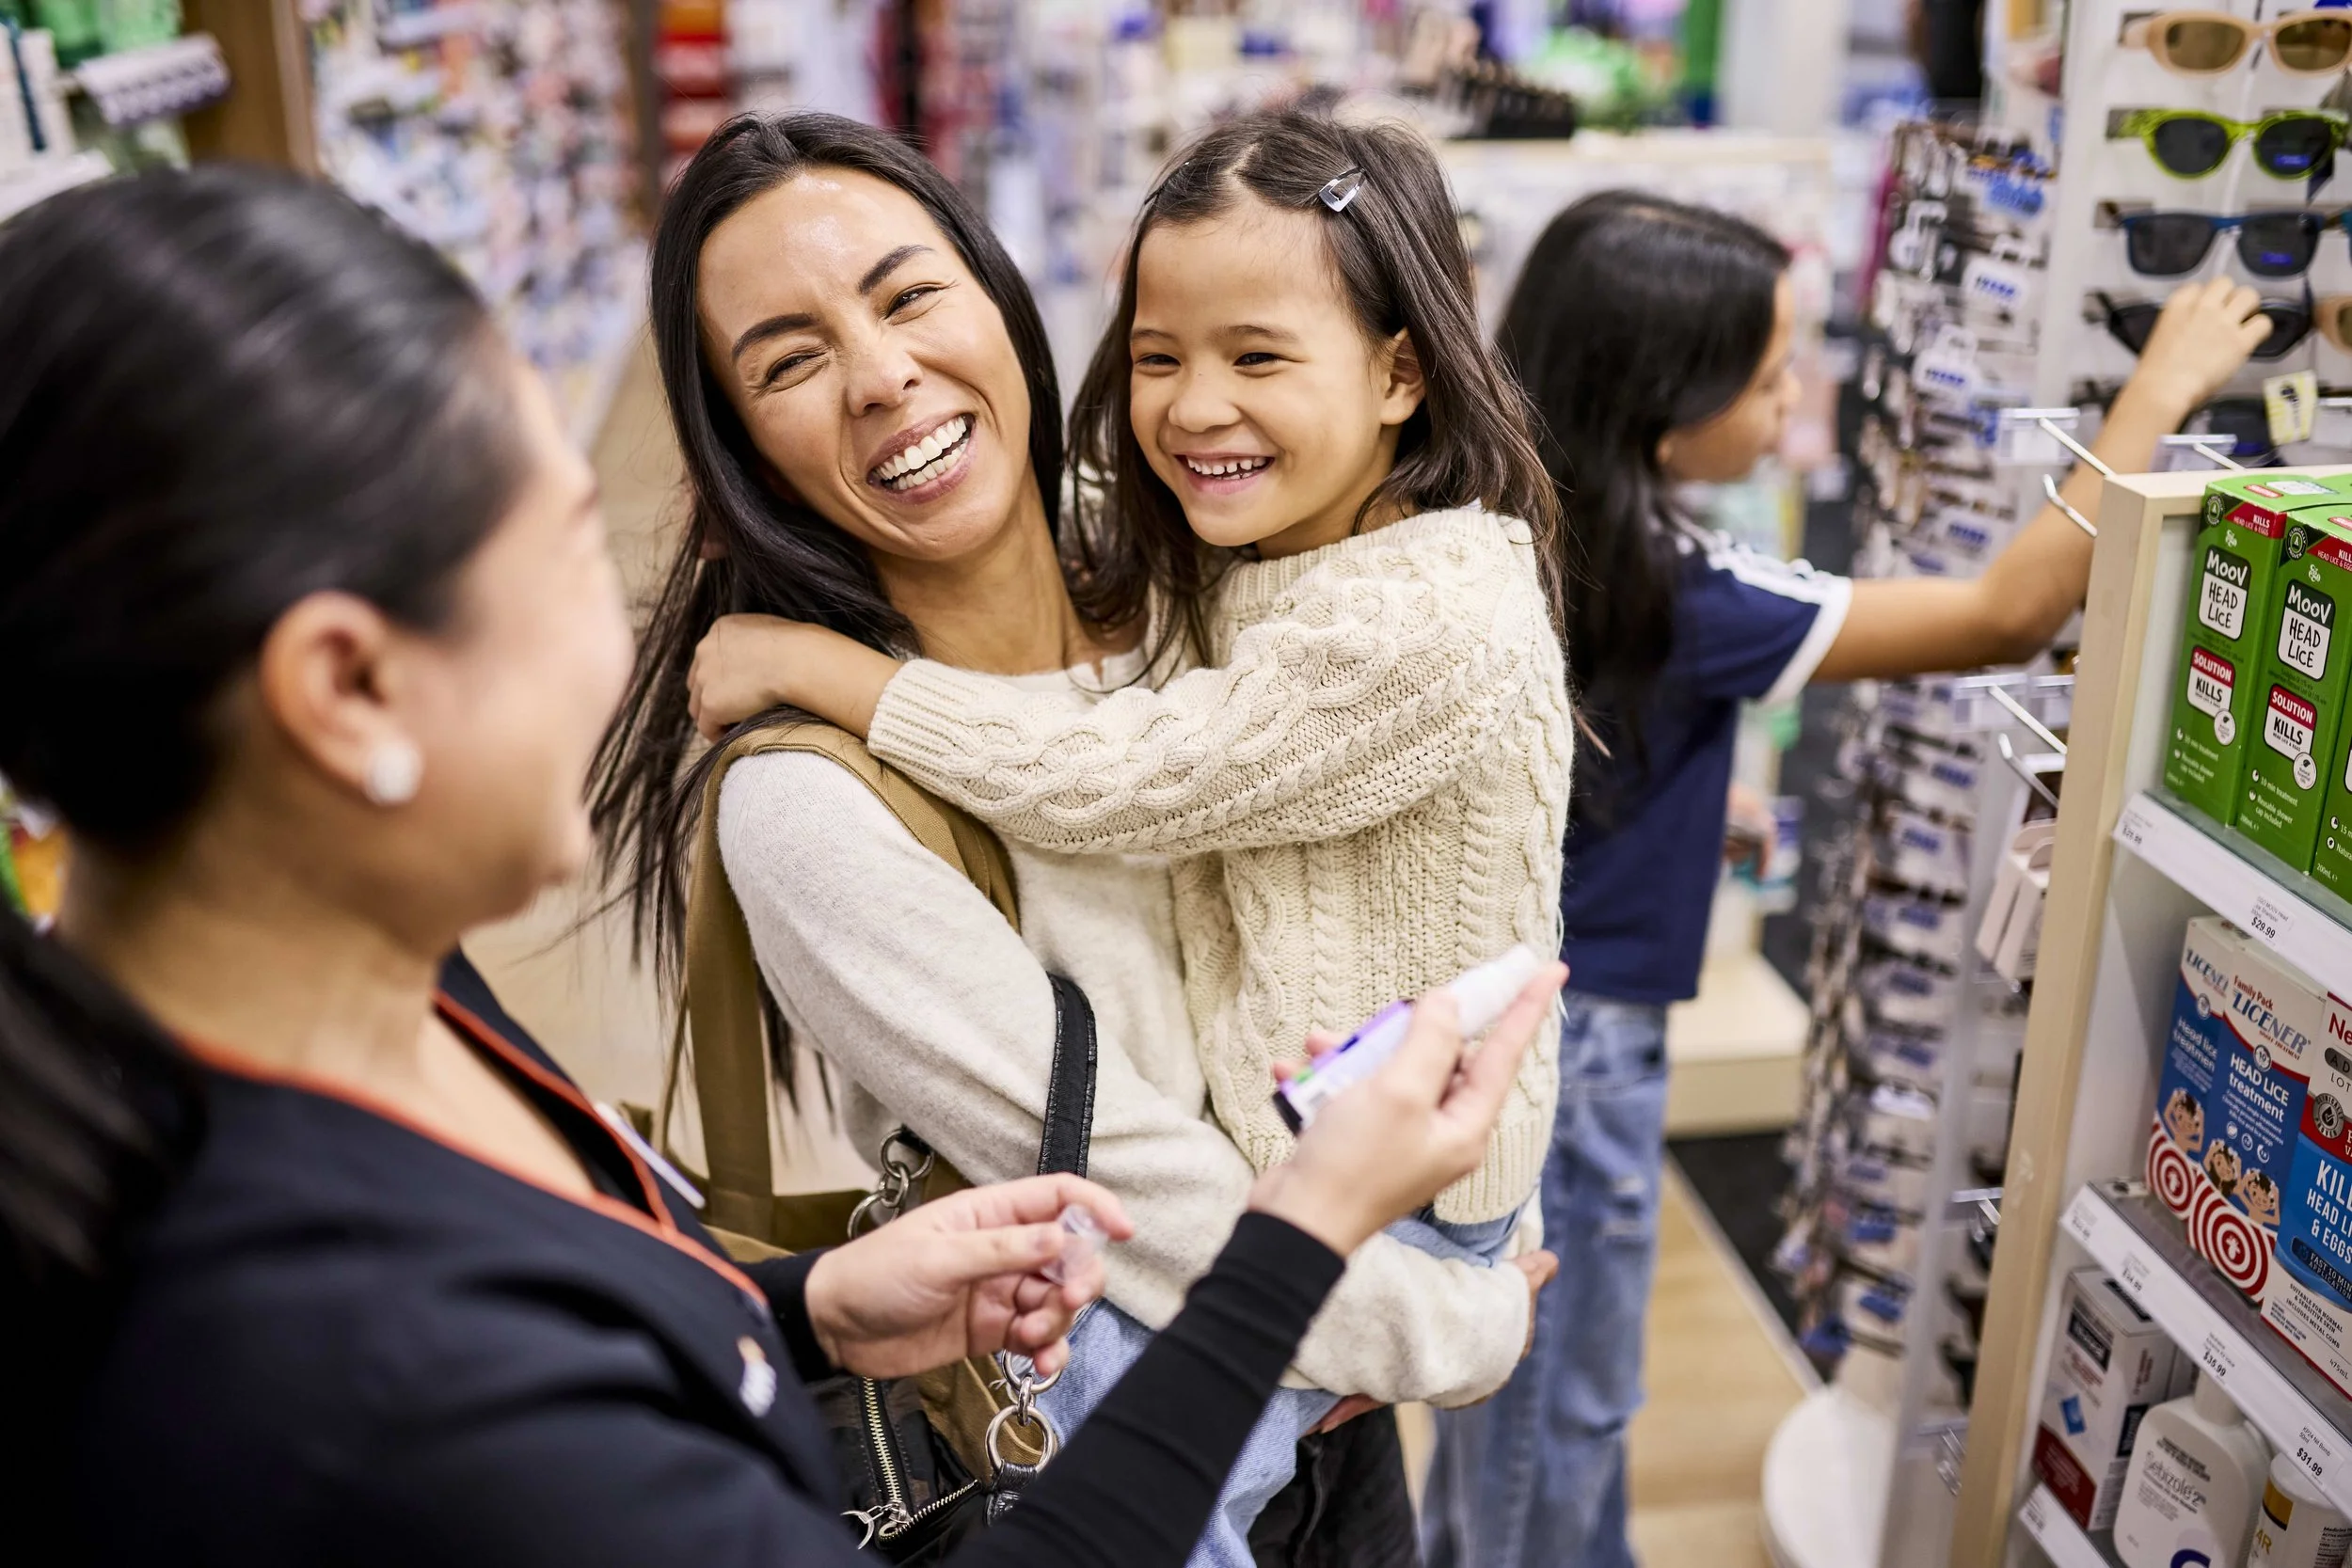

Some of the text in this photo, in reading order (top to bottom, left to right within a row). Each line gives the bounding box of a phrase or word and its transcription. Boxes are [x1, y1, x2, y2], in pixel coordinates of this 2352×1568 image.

[2252, 514, 2270, 528] KILLS
[2317, 549, 2330, 562] HEAD
[2329, 555, 2340, 566] LICE
[2209, 581, 2238, 610] HEAD
[2207, 603, 2233, 629] LICE
[2289, 617, 2321, 648] HEAD
[2194, 651, 2233, 682] SOLUTION
[2287, 640, 2314, 668] LICE
[2196, 676, 2223, 703] KILLS
[2272, 690, 2313, 724] SOLUTION
[2273, 717, 2304, 745] KILLS
[2275, 786, 2298, 807] treatment
[2340, 824, 2348, 835] 15
[2316, 863, 2331, 879] 200mL
[2250, 916, 2276, 939] $29.99
[2233, 974, 2257, 1000] Family
[2257, 990, 2274, 1012] Pack
[2328, 1011, 2352, 1046] Ne
[2231, 1053, 2263, 1085] HEAD
[2263, 1077, 2289, 1107] LICE
[2331, 1072, 2352, 1092] LOT
[2229, 1072, 2284, 1123] treatment
[2316, 1159, 2352, 1212] KILL
[2306, 1188, 2339, 1226] HEAD
[2311, 1218, 2352, 1264] & EGGS
[2309, 1261, 2352, 1300] APPLICATION
[2311, 1252, 2328, 1271] FAST
[2328, 1268, 2337, 1279] 10
[2290, 1283, 2312, 1306] SUITABLE
[2312, 1302, 2323, 1314] FOR
[2322, 1311, 2344, 1333] NORMAL
[2298, 1298, 2324, 1323] SENSITIVE
[2323, 1320, 2336, 1334] SKIN
[2286, 1298, 2310, 1322] INCLUDES
[2310, 1319, 2326, 1336] METAL
[2326, 1333, 2341, 1349] COMB
[2329, 1358, 2348, 1380] 475mL
[2302, 1426, 2314, 1439] KP24
[2319, 1442, 2331, 1457] Bomb
[2296, 1448, 2323, 1477] $31.99
